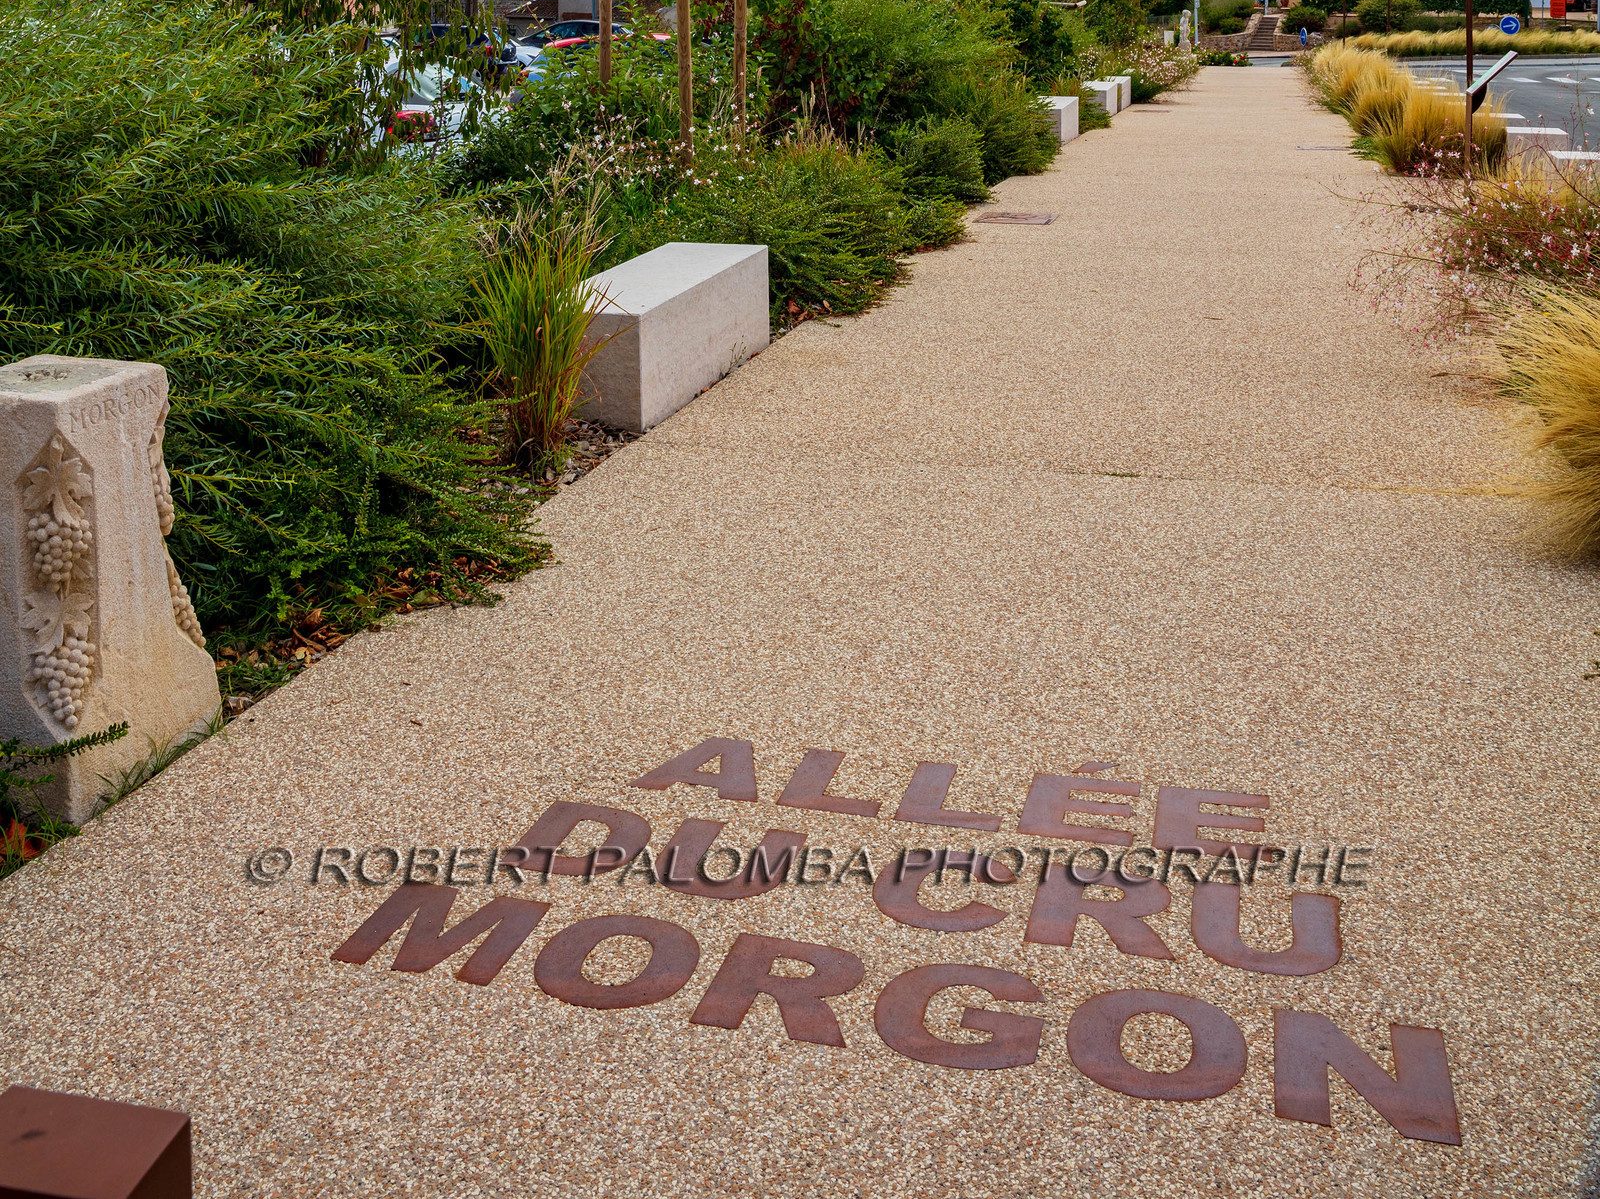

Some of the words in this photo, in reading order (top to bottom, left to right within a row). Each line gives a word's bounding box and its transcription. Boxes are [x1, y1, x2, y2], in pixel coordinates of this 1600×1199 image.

[69, 383, 161, 433] MORGON
[629, 737, 1272, 862] ALLÉE
[499, 800, 808, 899] DU
[872, 850, 1342, 975] CRU
[330, 883, 1462, 1146] MORGON
